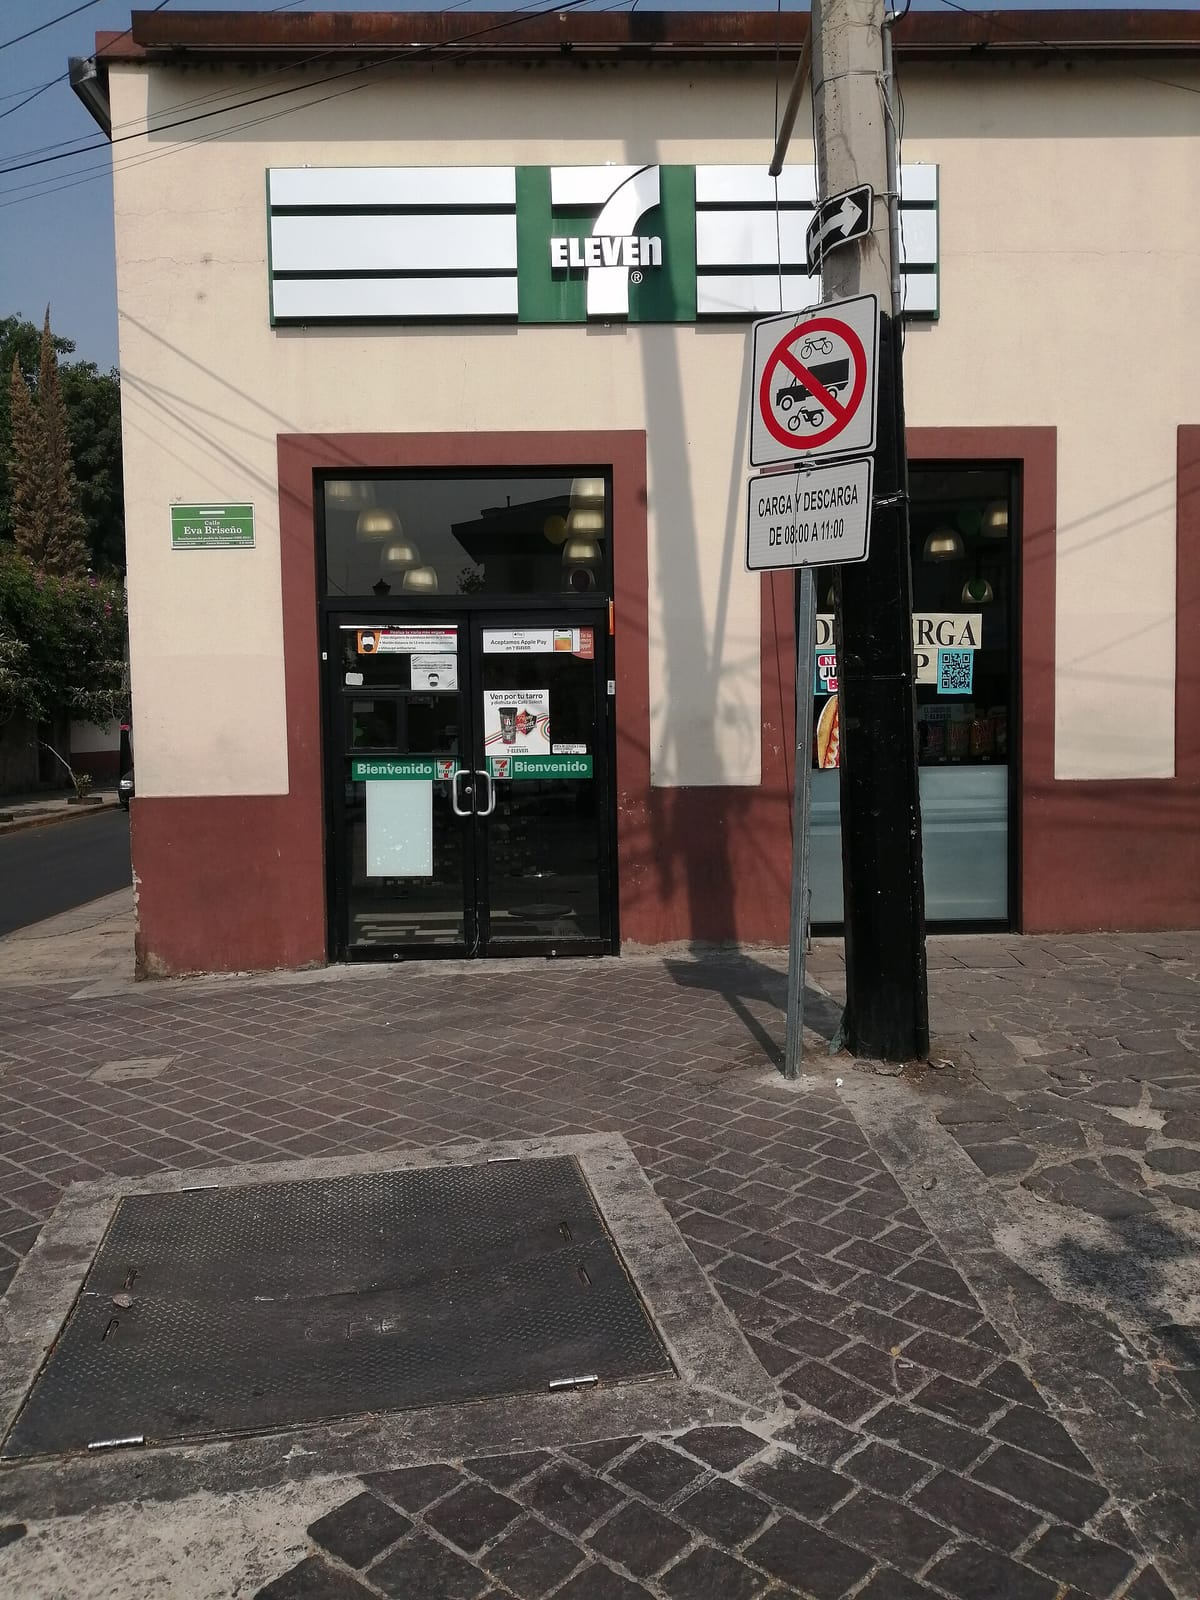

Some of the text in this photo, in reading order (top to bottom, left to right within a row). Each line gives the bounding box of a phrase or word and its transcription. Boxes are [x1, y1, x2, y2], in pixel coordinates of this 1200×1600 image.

[758, 483, 859, 518] CARGA Y DESCARGA
[183, 525, 243, 535] Eva Briseño
[768, 518, 845, 547] DE 08:00 A 11:00
[356, 762, 433, 775] Bienvenido
[514, 761, 588, 774] Bienvenido
